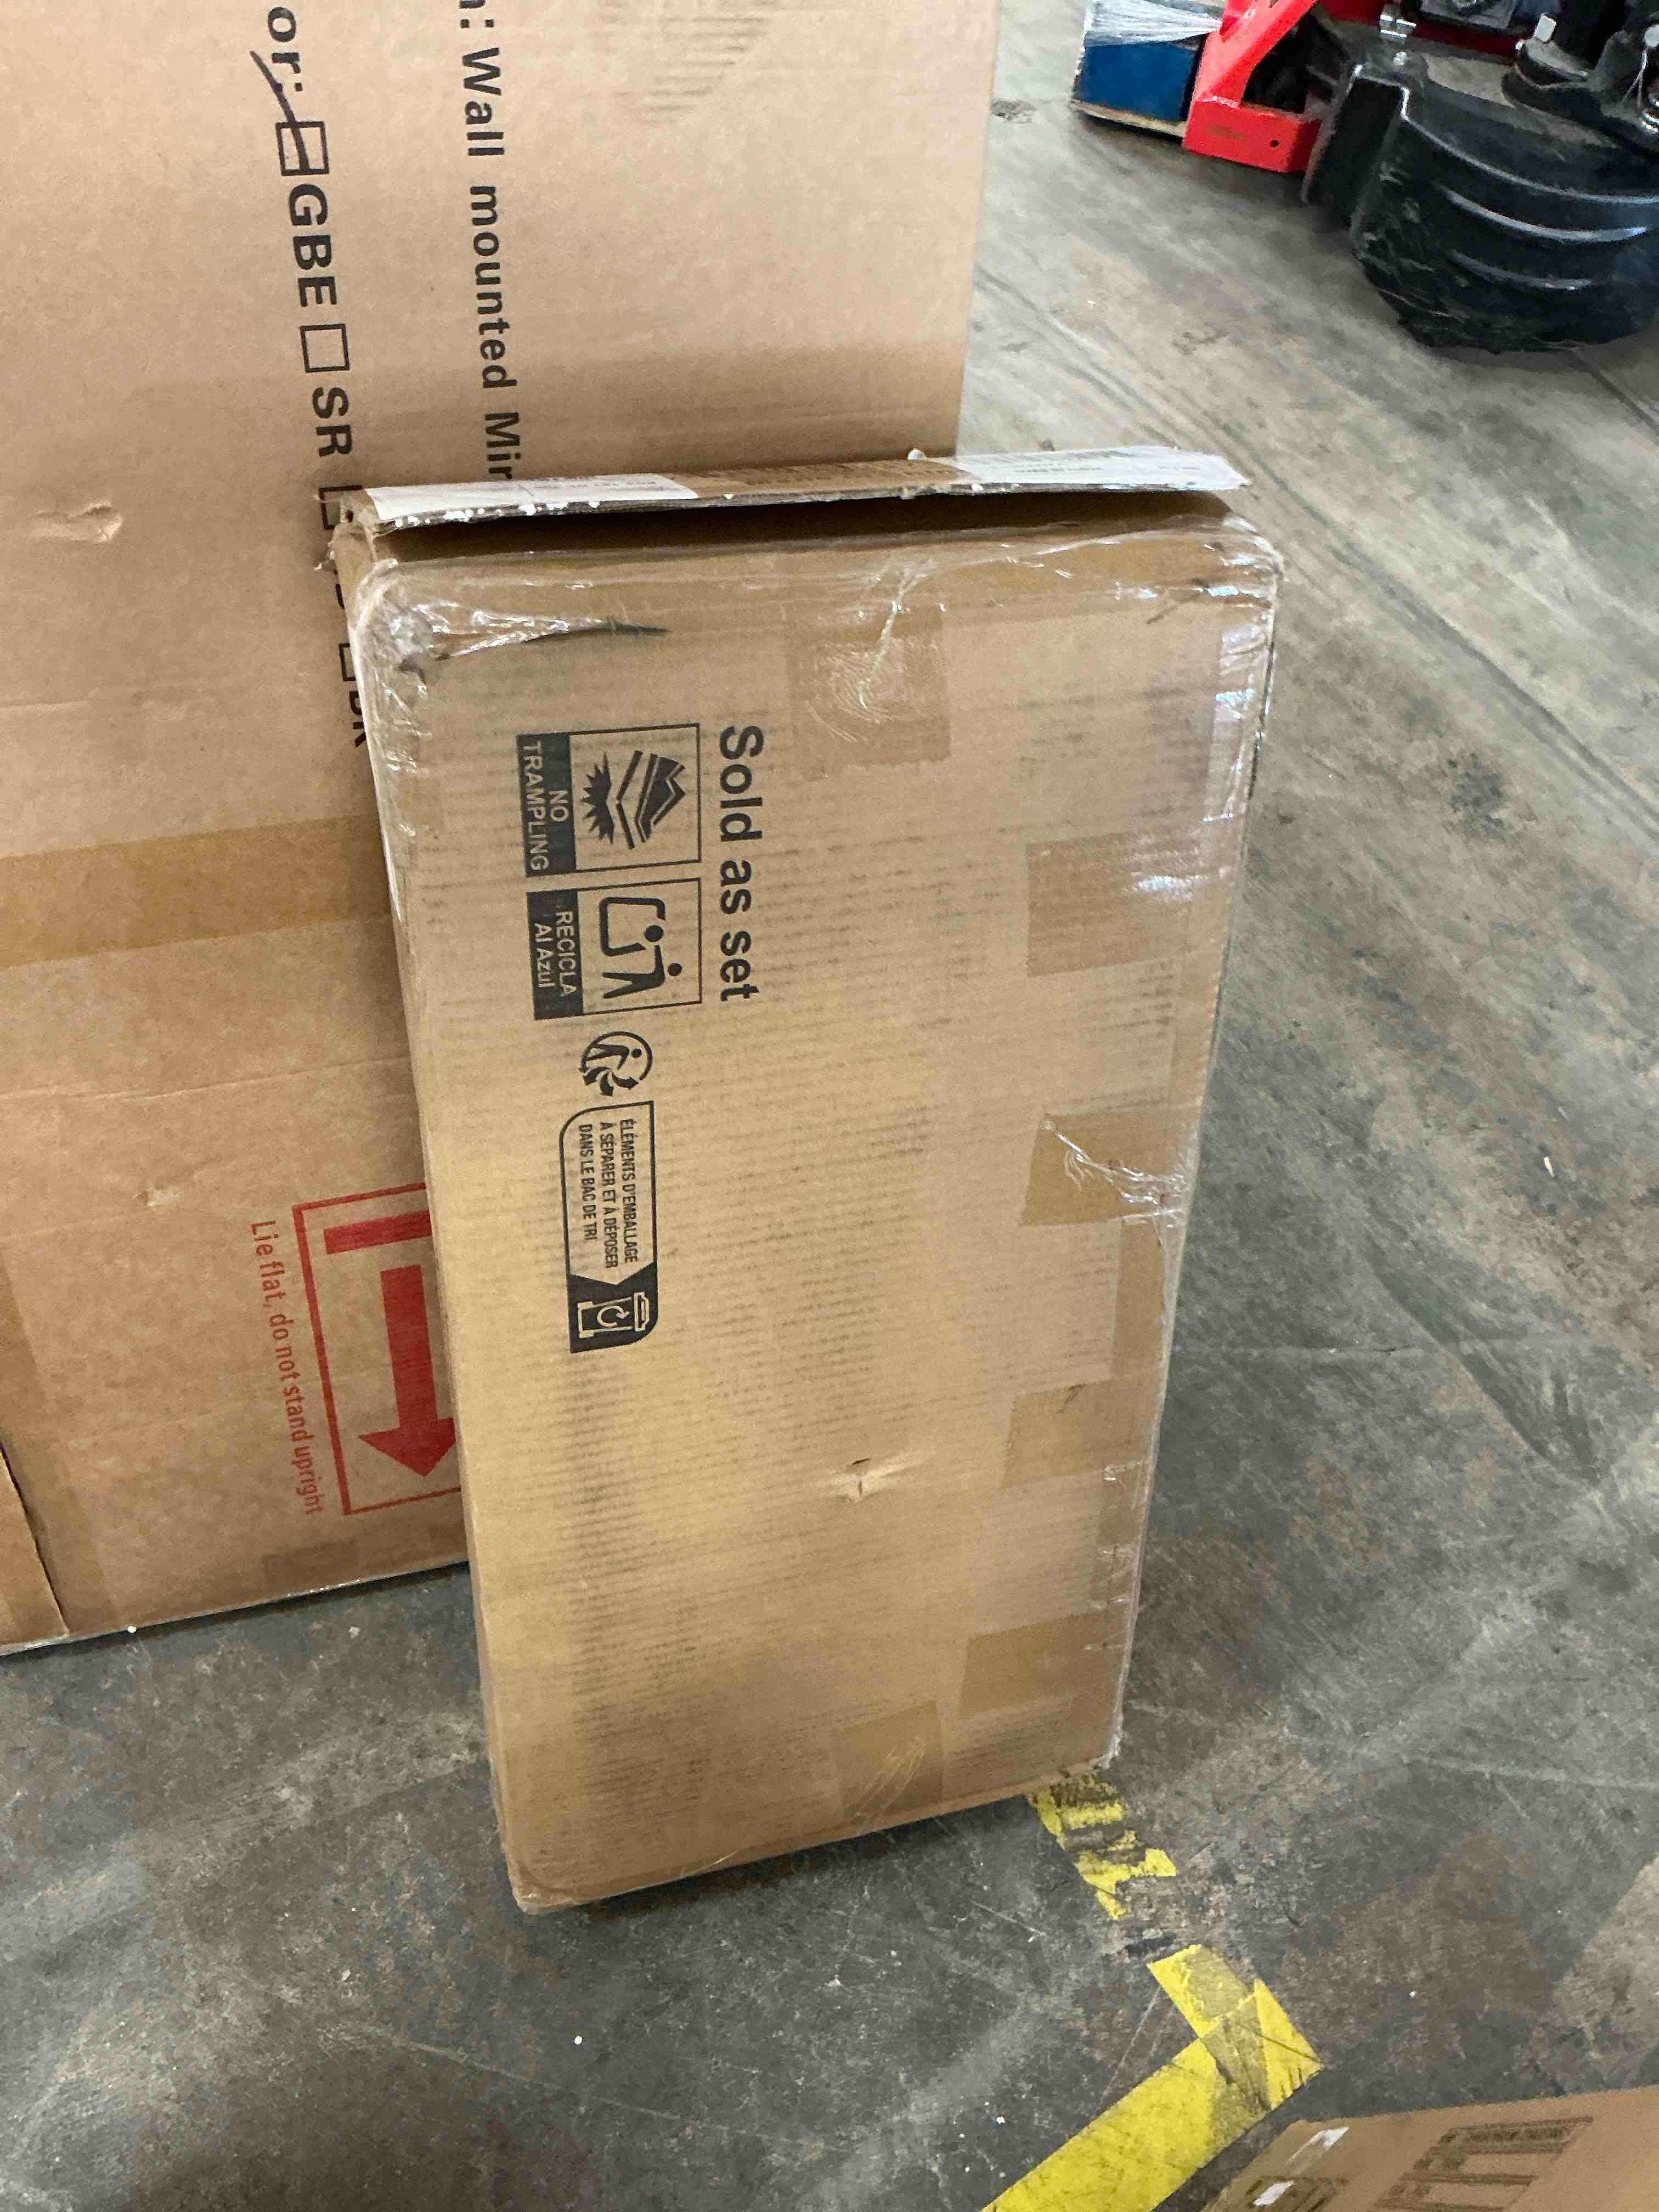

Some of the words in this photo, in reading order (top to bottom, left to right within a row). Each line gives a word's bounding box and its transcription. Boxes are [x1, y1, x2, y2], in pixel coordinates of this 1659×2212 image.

[461, 47, 505, 156] Wall
[288, 184, 337, 308] GBE
[469, 186, 518, 389] mounted
[312, 387, 353, 458] SR
[522, 740, 549, 871] TRAMPLING
[548, 789, 569, 822] NO
[719, 725, 764, 842] Sold
[719, 860, 752, 915] as
[536, 947, 556, 988] Azul
[555, 911, 577, 997] RECICLA
[719, 930, 759, 1002] set
[579, 1124, 594, 1157] DANS
[600, 1133, 617, 1186] SÉPARER
[620, 1118, 637, 1181] ÉLÉMENTS
[580, 1160, 595, 1175] LE
[582, 1177, 596, 1201] BAC
[583, 1205, 596, 1220] DE
[602, 1189, 616, 1203] ET
[251, 1221, 279, 1256] Lie
[583, 1222, 597, 1240] TRI
[603, 1217, 620, 1269] DÉPOSER
[622, 1184, 638, 1262] D'EMBALLAGE
[259, 1261, 286, 1307] flat,
[269, 1314, 294, 1340] do
[275, 1346, 301, 1382] not
[283, 1386, 315, 1442] stand
[292, 1446, 325, 1515] upright
